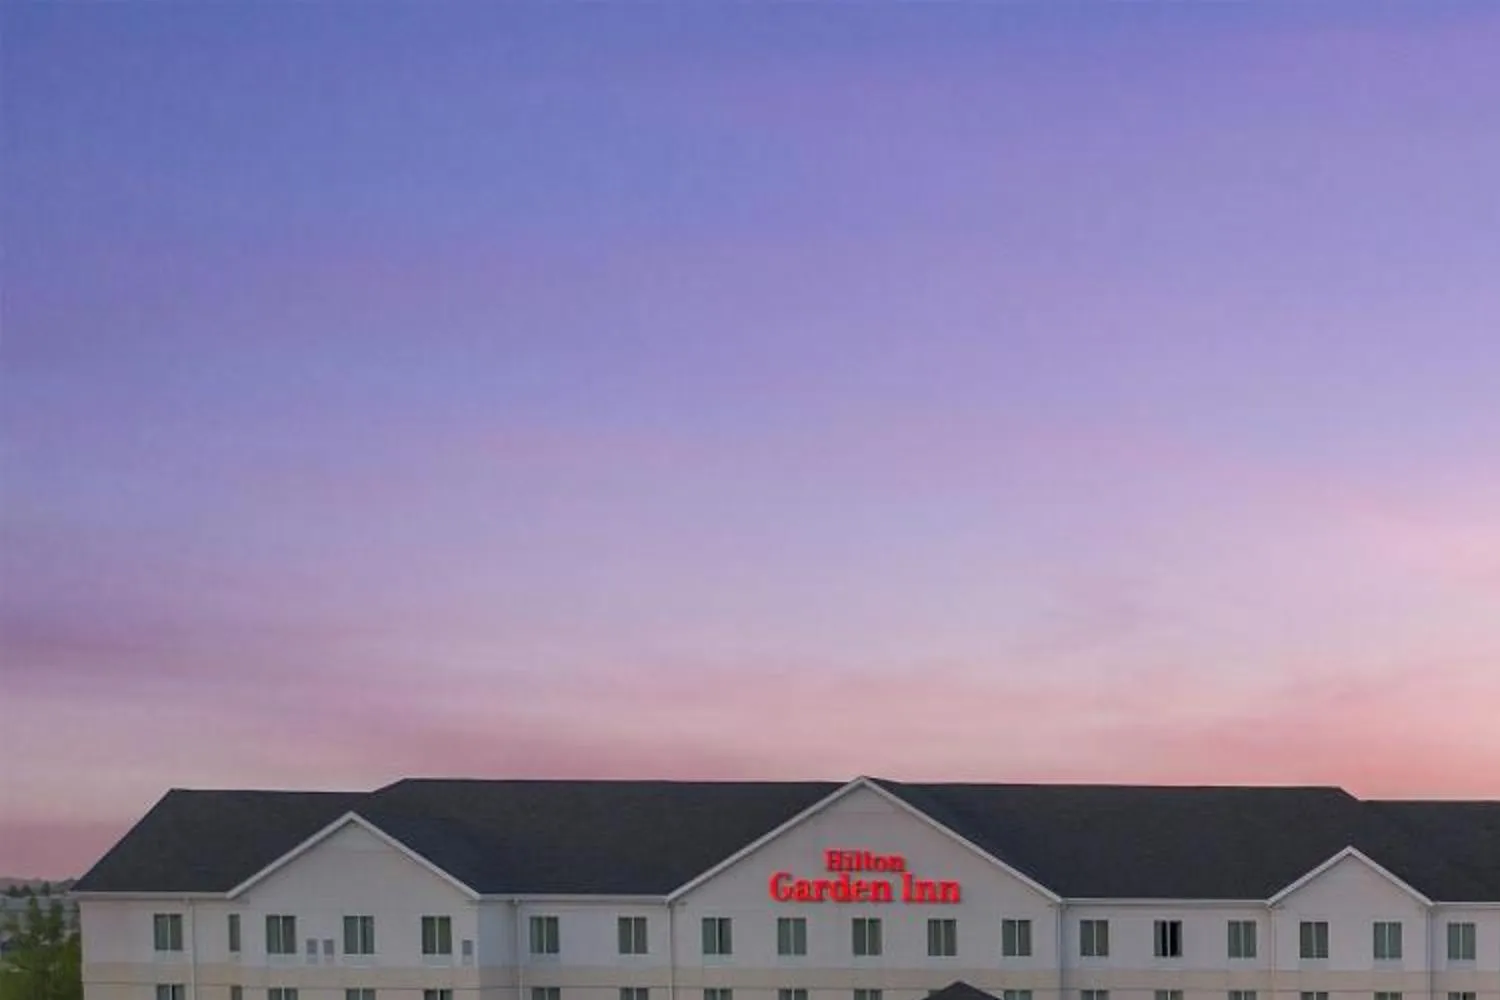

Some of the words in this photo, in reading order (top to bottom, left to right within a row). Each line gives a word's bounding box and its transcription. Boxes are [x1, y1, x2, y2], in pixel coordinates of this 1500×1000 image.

[825, 849, 906, 872] Hilton
[769, 870, 893, 903] Garden
[902, 871, 961, 904] Inn
